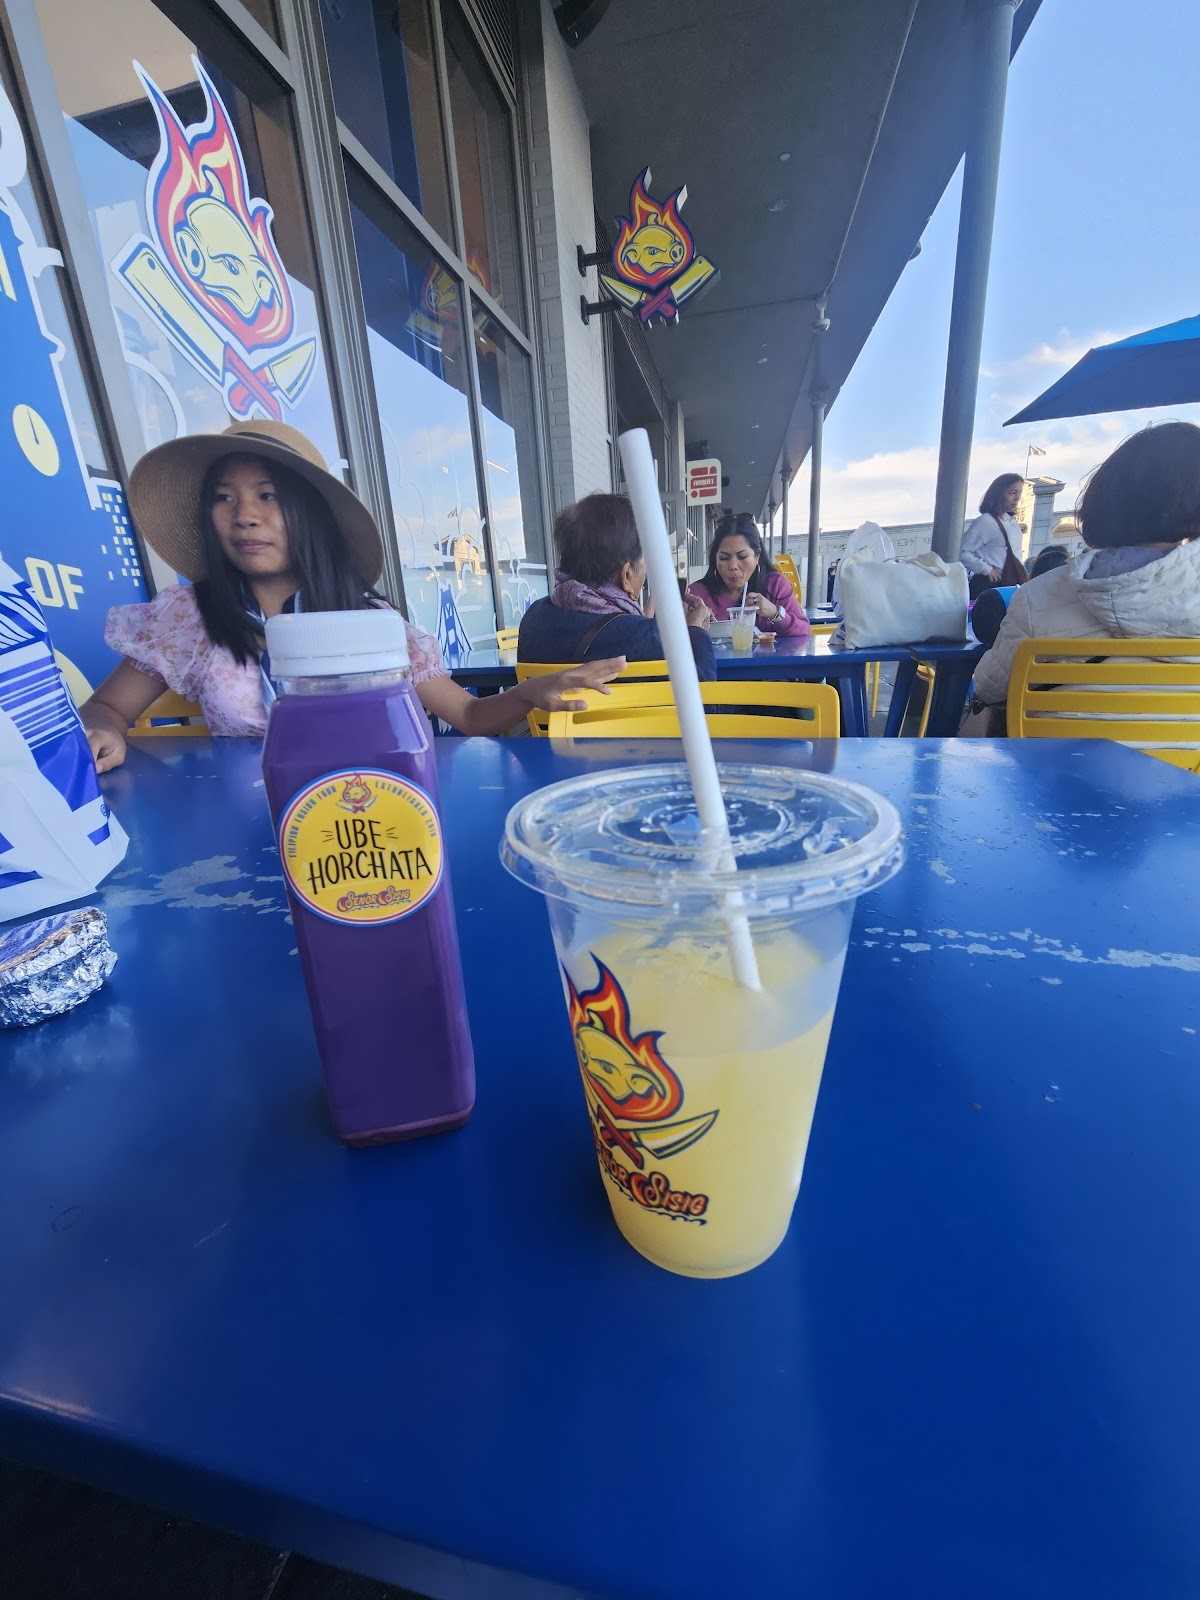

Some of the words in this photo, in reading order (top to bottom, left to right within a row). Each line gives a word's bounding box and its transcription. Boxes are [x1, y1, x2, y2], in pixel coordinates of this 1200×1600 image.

[24, 556, 84, 610] OF
[287, 825, 299, 858] FILIPINO
[294, 798, 317, 824] FUSION
[316, 785, 337, 800] FOOD
[375, 781, 428, 816] ESTABLISHED
[335, 818, 386, 850] UBE
[307, 847, 433, 895] HORCHATA
